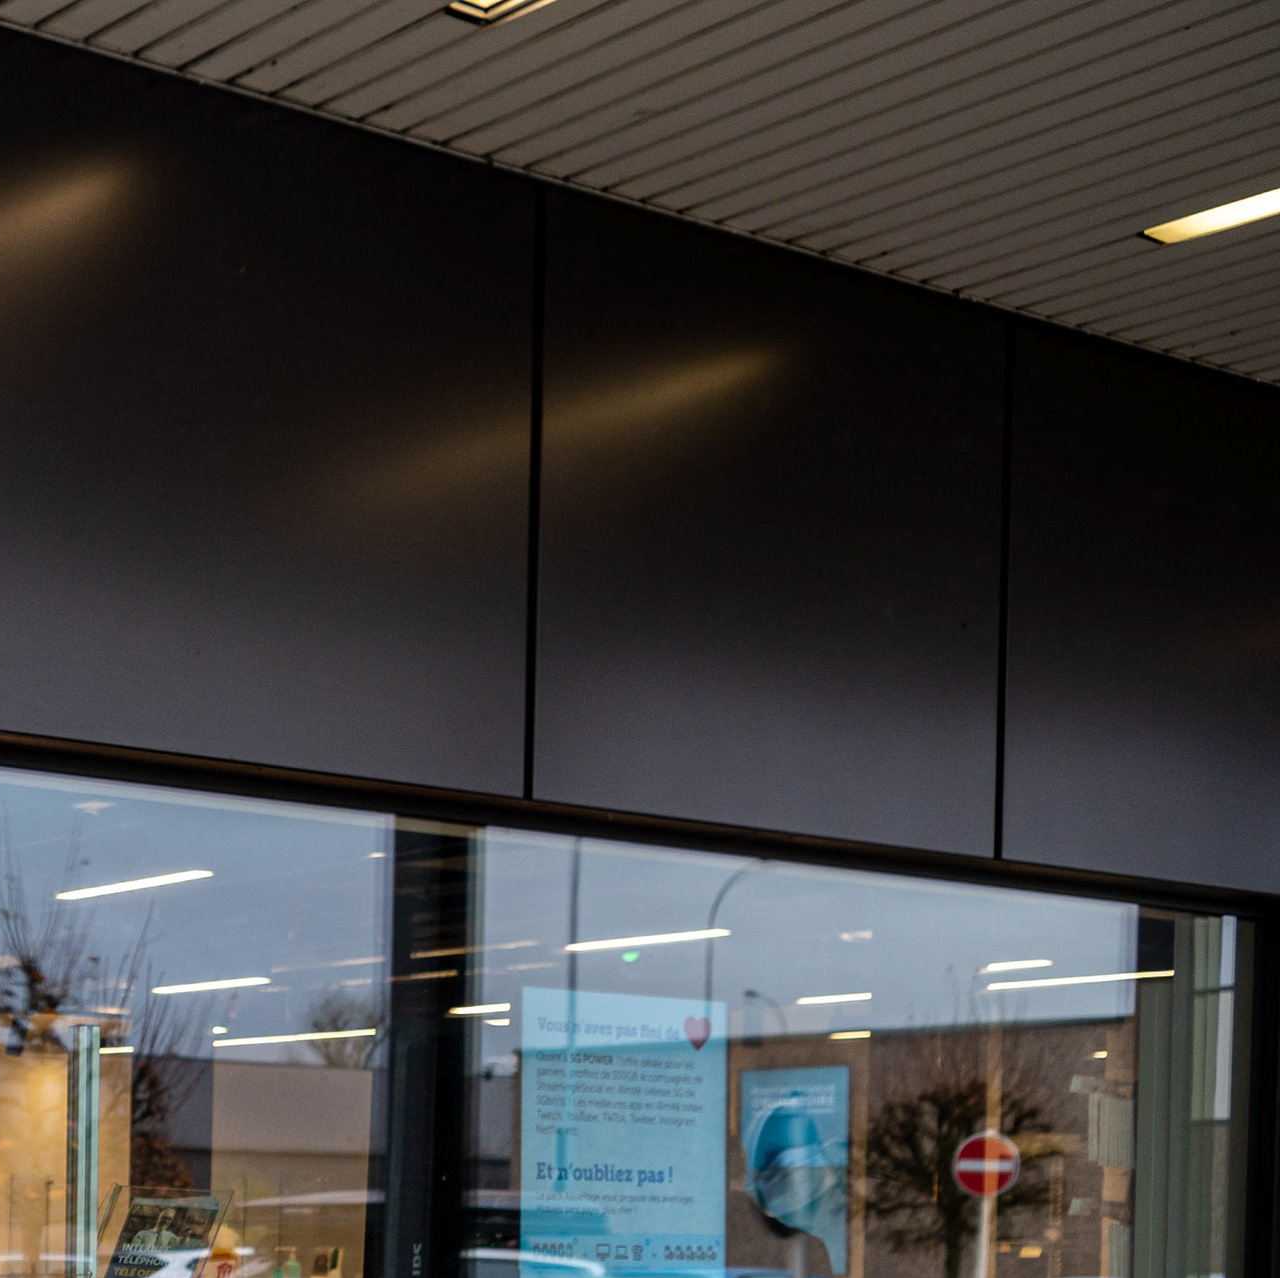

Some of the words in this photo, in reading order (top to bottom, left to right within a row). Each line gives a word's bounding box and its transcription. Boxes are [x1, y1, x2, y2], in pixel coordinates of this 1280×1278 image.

[536, 1162, 553, 1180] Et
[557, 1163, 632, 1182] n'oubliez
[637, 1169, 665, 1187] pas
